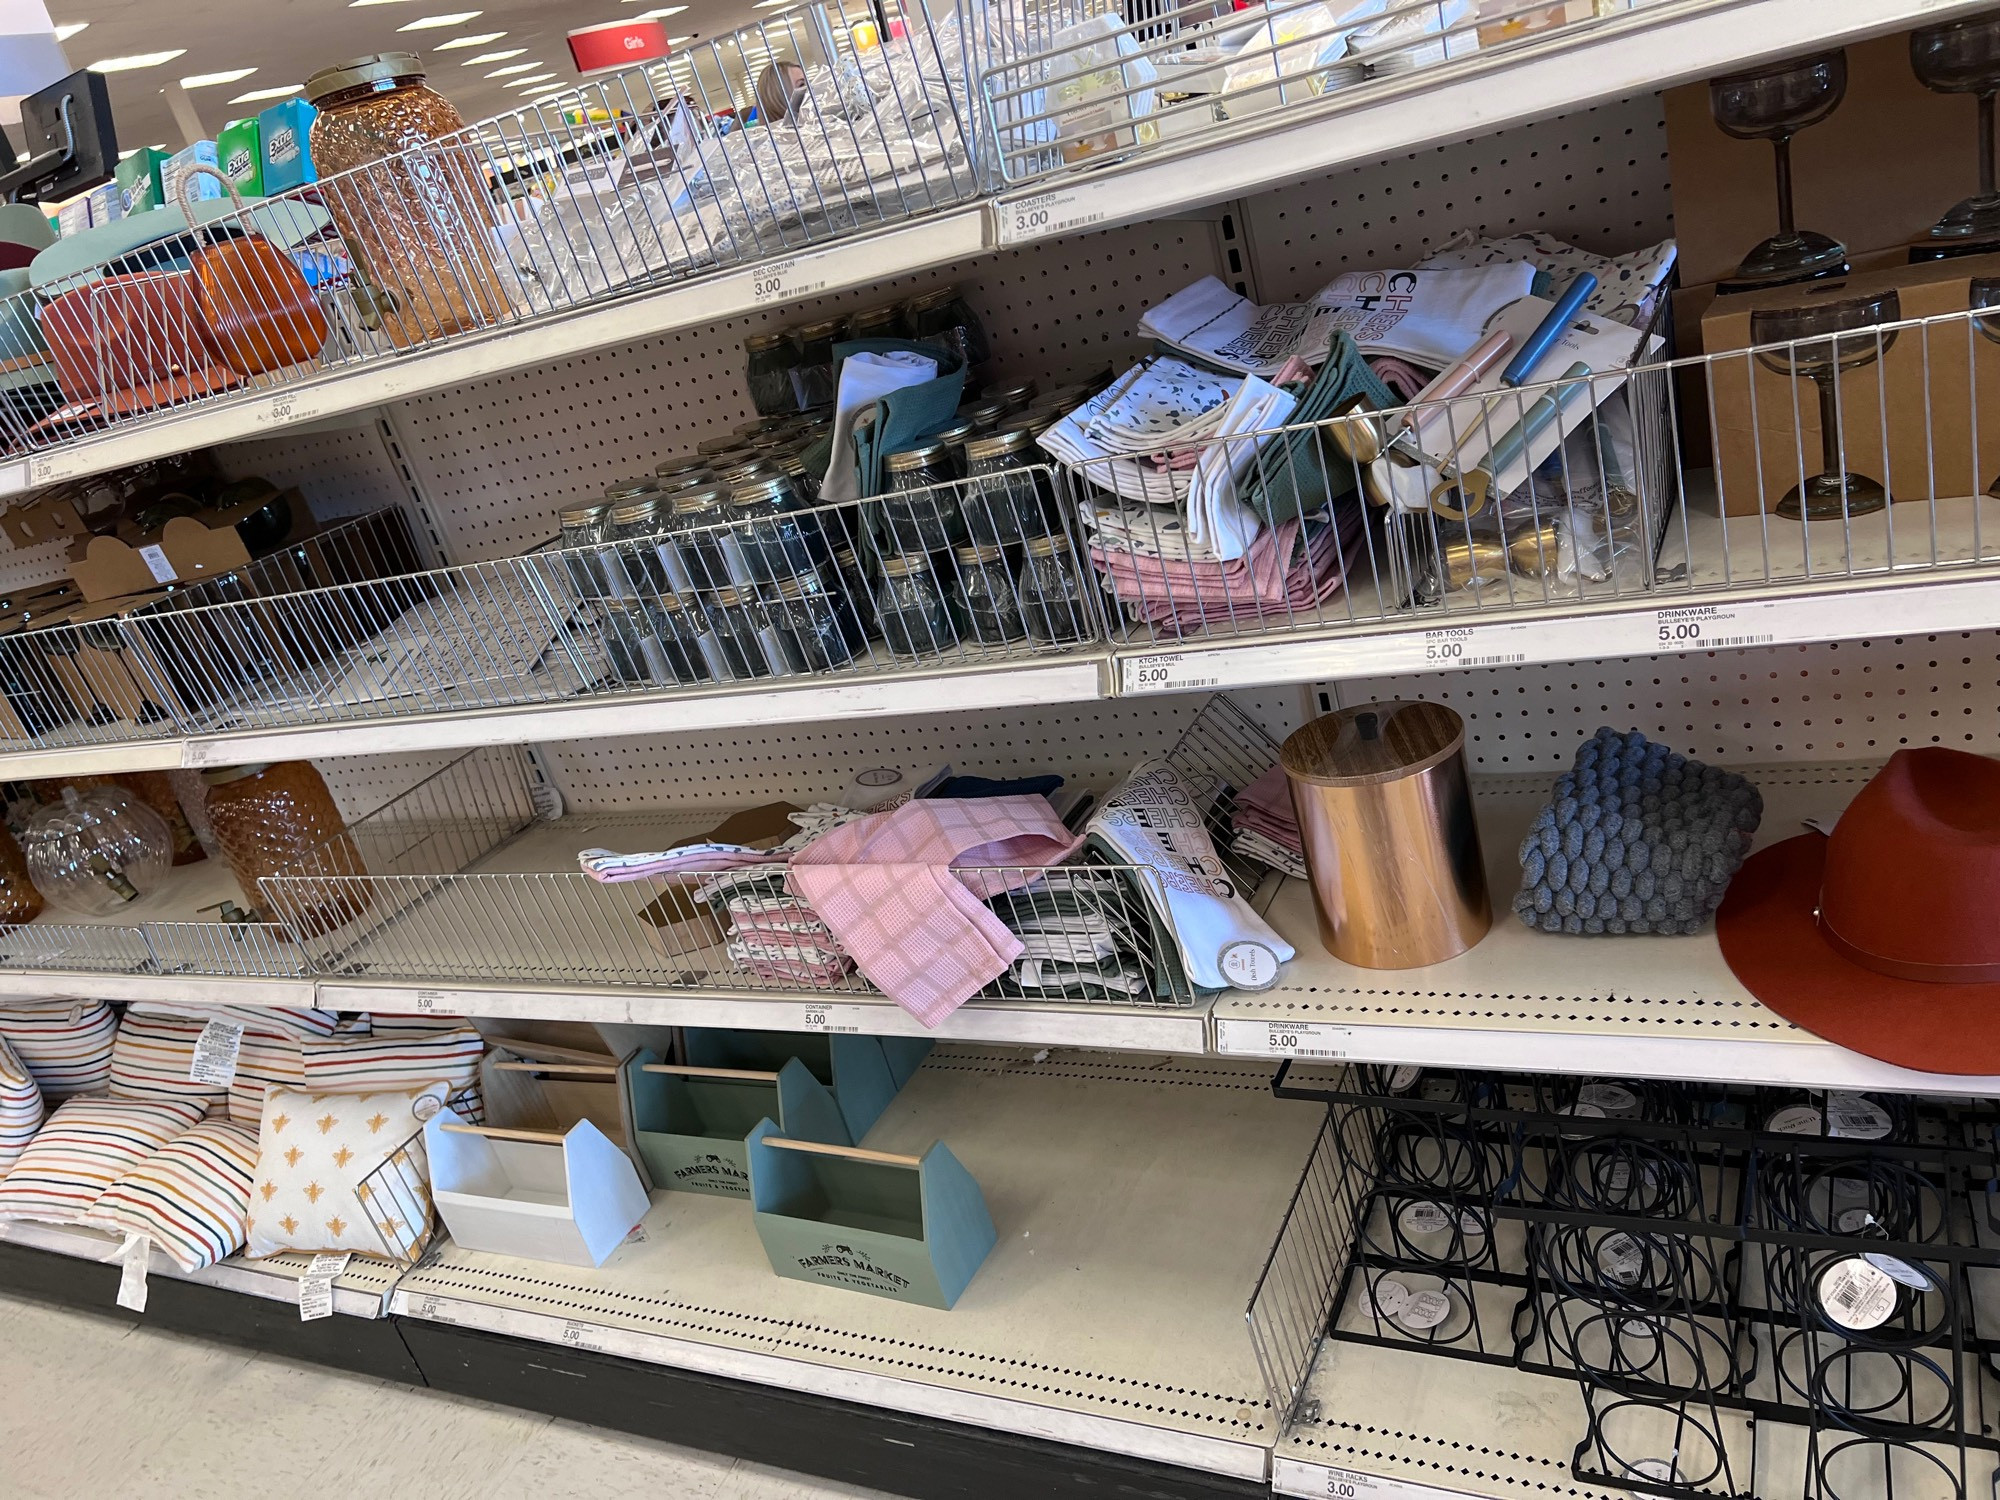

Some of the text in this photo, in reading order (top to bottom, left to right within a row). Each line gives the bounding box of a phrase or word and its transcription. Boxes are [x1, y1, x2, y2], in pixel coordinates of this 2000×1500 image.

[624, 36, 645, 50] Girls
[269, 128, 293, 158] Extra
[227, 149, 249, 178] Extra
[1015, 194, 1056, 210] COASTERS
[1016, 210, 1049, 230] 3.00
[753, 260, 795, 277] DEC CONTAIN
[755, 278, 781, 296] 3.00
[1354, 272, 1418, 341] CHEERS
[1561, 339, 1579, 350] Tools
[37, 465, 52, 477] 3.00
[1657, 607, 1717, 619] DRINKWARE
[1657, 613, 1736, 625] BULLSEYE'S PLAYGROUN
[1425, 628, 1474, 639] BAR TOOLS
[1658, 623, 1700, 640] 5.00
[1426, 643, 1462, 659] 5.00
[1138, 654, 1184, 665] KTCH TOWEL
[1138, 668, 1168, 683] 5.00
[1102, 807, 1201, 829] CHEERS
[1135, 846, 1223, 877] CHEERS
[417, 999, 433, 1008] 5.00
[805, 1014, 826, 1024] 5.00
[1268, 1022, 1309, 1030] DRINKWARE
[1269, 1034, 1298, 1047] 5.00
[673, 1165, 749, 1181] FARMERS MAR
[797, 1254, 911, 1289] FARMERS MARKET
[817, 1271, 841, 1281] FRUITS
[851, 1279, 898, 1293] VEGETABLES
[421, 1303, 437, 1314] 5.00
[563, 1329, 580, 1340] 5.00
[1328, 1469, 1368, 1483] WINE RACKS
[1327, 1481, 1355, 1498] 3.00
